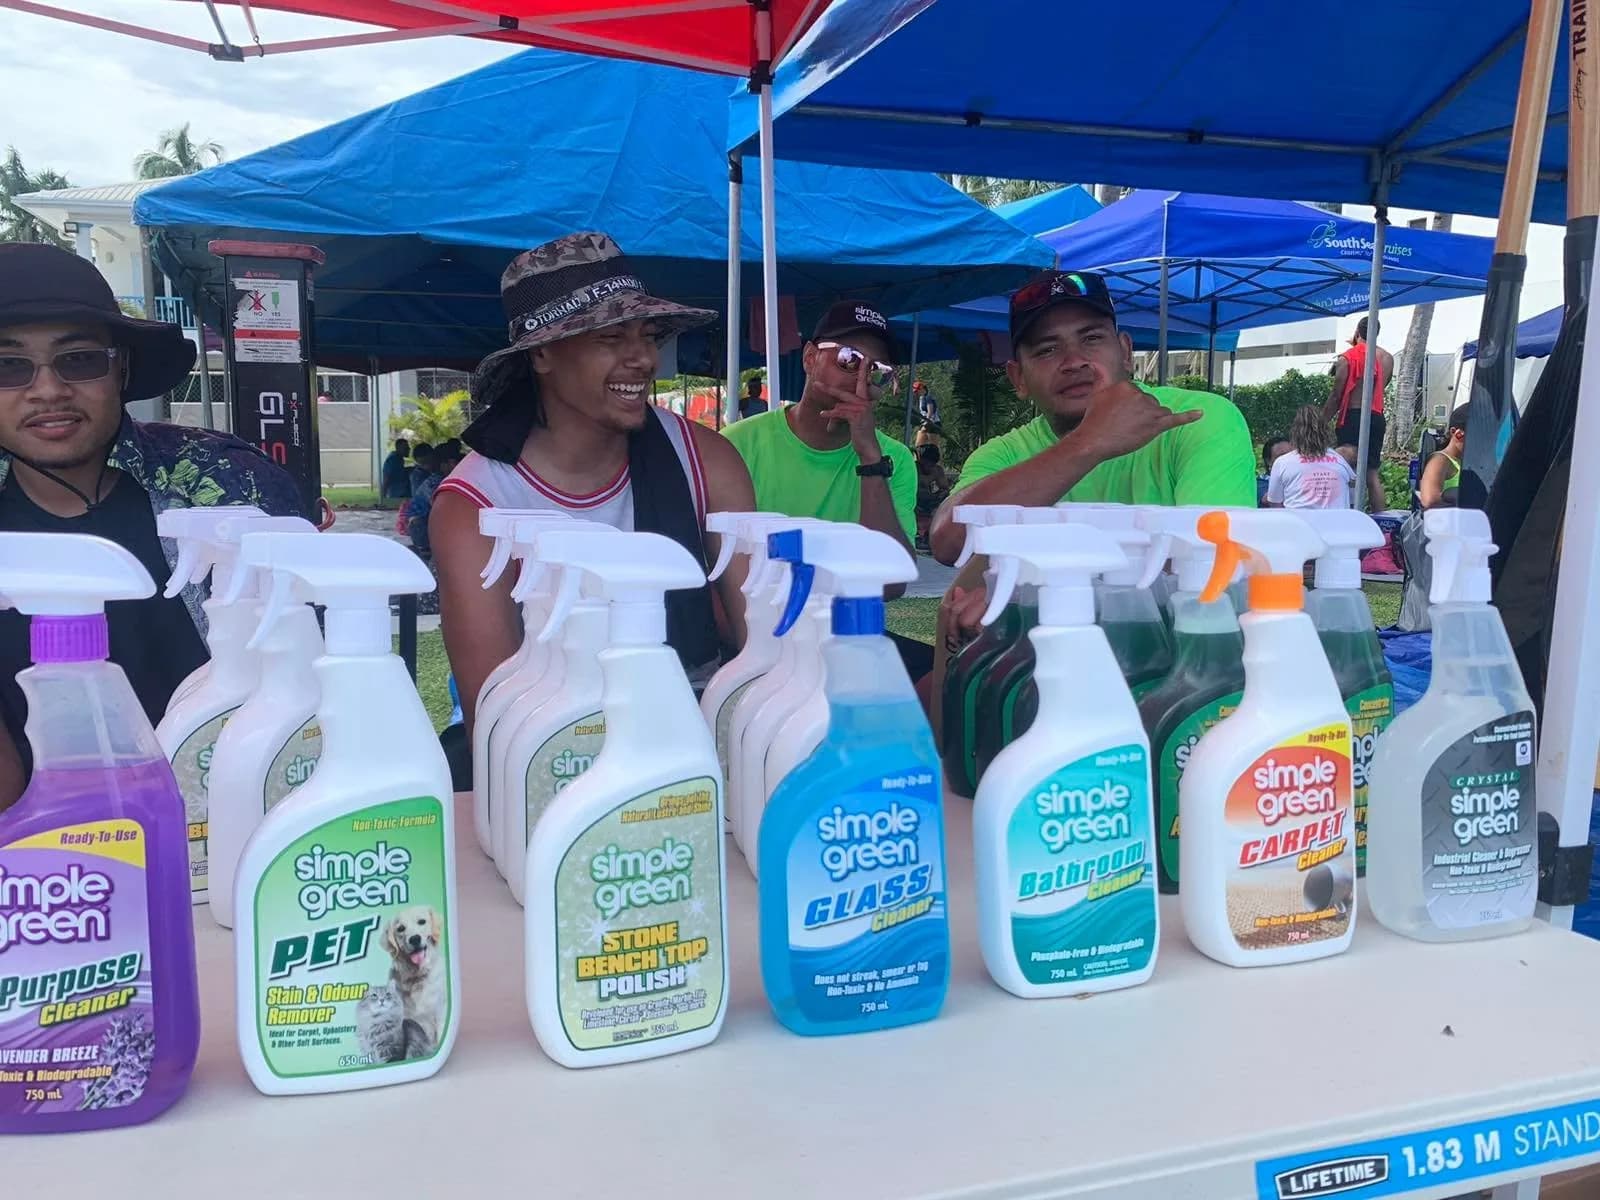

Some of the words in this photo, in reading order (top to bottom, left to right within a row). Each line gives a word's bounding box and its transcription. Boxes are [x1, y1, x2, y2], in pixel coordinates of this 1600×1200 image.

[1326, 236, 1359, 249] South
[1383, 244, 1412, 257] ruises
[1308, 730, 1346, 743] Ready-To-Use
[881, 774, 932, 790] Ready-To-Use
[1254, 757, 1337, 790] simple
[1457, 772, 1517, 786] CRYSTAL
[1036, 780, 1130, 817] simple
[1257, 787, 1336, 825] green
[1451, 784, 1520, 817] simple
[60, 828, 138, 845] Ready-To-Use
[352, 818, 398, 832] Non-Toxic
[399, 814, 436, 828] Formula
[818, 803, 919, 841] simple
[1041, 811, 1131, 853] green
[1239, 808, 1346, 868] CARPET
[1454, 811, 1519, 845] green
[295, 841, 411, 882] simple
[591, 839, 693, 882] simple
[822, 837, 918, 881] green
[1018, 840, 1145, 901] Bathroom
[1297, 839, 1346, 872] Cleaner
[1433, 852, 1471, 866] Industrial
[299, 876, 409, 920] green
[594, 874, 691, 919] green
[804, 864, 932, 929] GLASS
[1087, 865, 1145, 901] Cleaner
[871, 896, 934, 932] Cleaner
[270, 916, 380, 979] PET
[603, 921, 679, 953] STONE
[576, 948, 659, 981] BENCH
[663, 937, 708, 965] TOP
[815, 974, 835, 985] Does
[837, 972, 850, 983] not
[852, 968, 880, 982] streak,
[882, 965, 906, 978] smear
[907, 964, 917, 974] or
[1050, 968, 1065, 979] 750
[0, 952, 140, 1006] Purpose
[266, 985, 306, 1005] Stain
[307, 985, 319, 1004] &
[321, 983, 368, 1003] Odour
[599, 965, 686, 1001] POLISH
[827, 983, 865, 997] Non-Toxic
[40, 987, 136, 1026] Cleaner
[267, 1005, 335, 1026] Remover
[861, 1002, 877, 1013] 750
[269, 1029, 284, 1038] Ideal
[285, 1028, 295, 1037] for
[297, 1026, 321, 1038] Carpet,
[323, 1024, 357, 1036] Upholstery
[278, 1039, 294, 1048] Other
[296, 1038, 309, 1047] Soft
[52, 1045, 99, 1062] BREEZE
[339, 1054, 357, 1066] 650
[26, 1069, 34, 1082] &
[37, 1065, 113, 1082] Biodegradable
[25, 1089, 45, 1100] 750
[47, 1088, 62, 1100] mL
[1289, 1160, 1377, 1194] LIFETIME
[1401, 1137, 1464, 1177] 1.83
[1474, 1130, 1500, 1164] M
